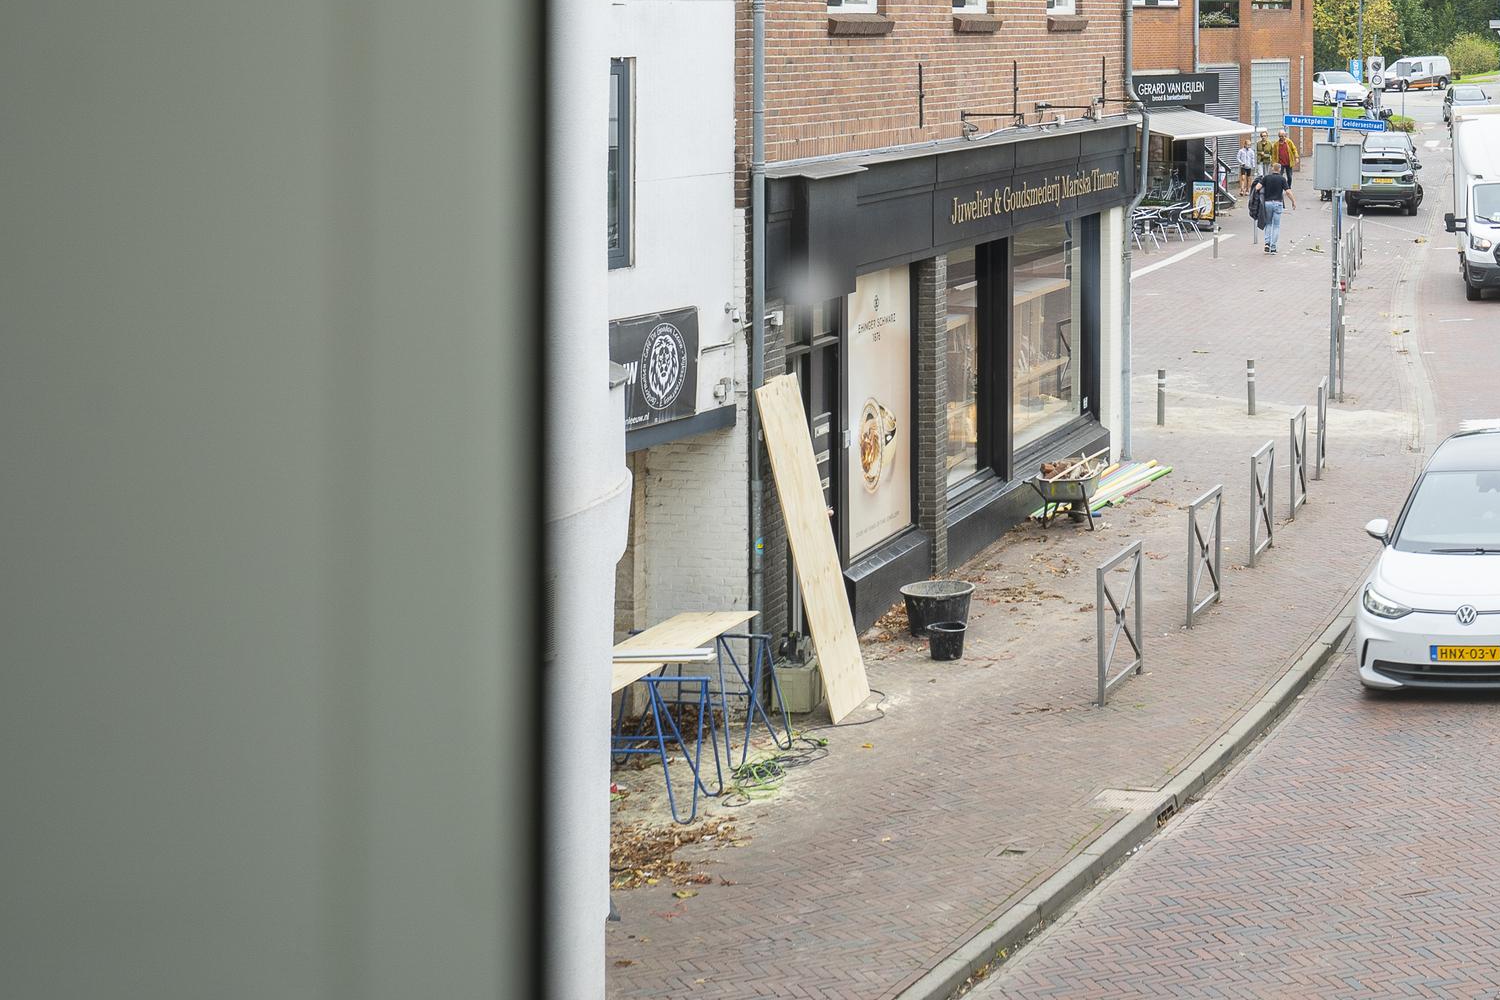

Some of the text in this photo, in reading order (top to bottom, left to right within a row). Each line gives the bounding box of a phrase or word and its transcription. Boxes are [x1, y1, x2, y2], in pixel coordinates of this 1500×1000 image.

[1138, 81, 1205, 95] GERARD VAN KEULEN
[1291, 117, 1328, 126] Marktplein
[1343, 119, 1383, 130] Geldersestraat
[951, 168, 1120, 225] Juwelier & Goudsmederij Mariska Timmer
[1439, 648, 1497, 660] HNX-03-V
